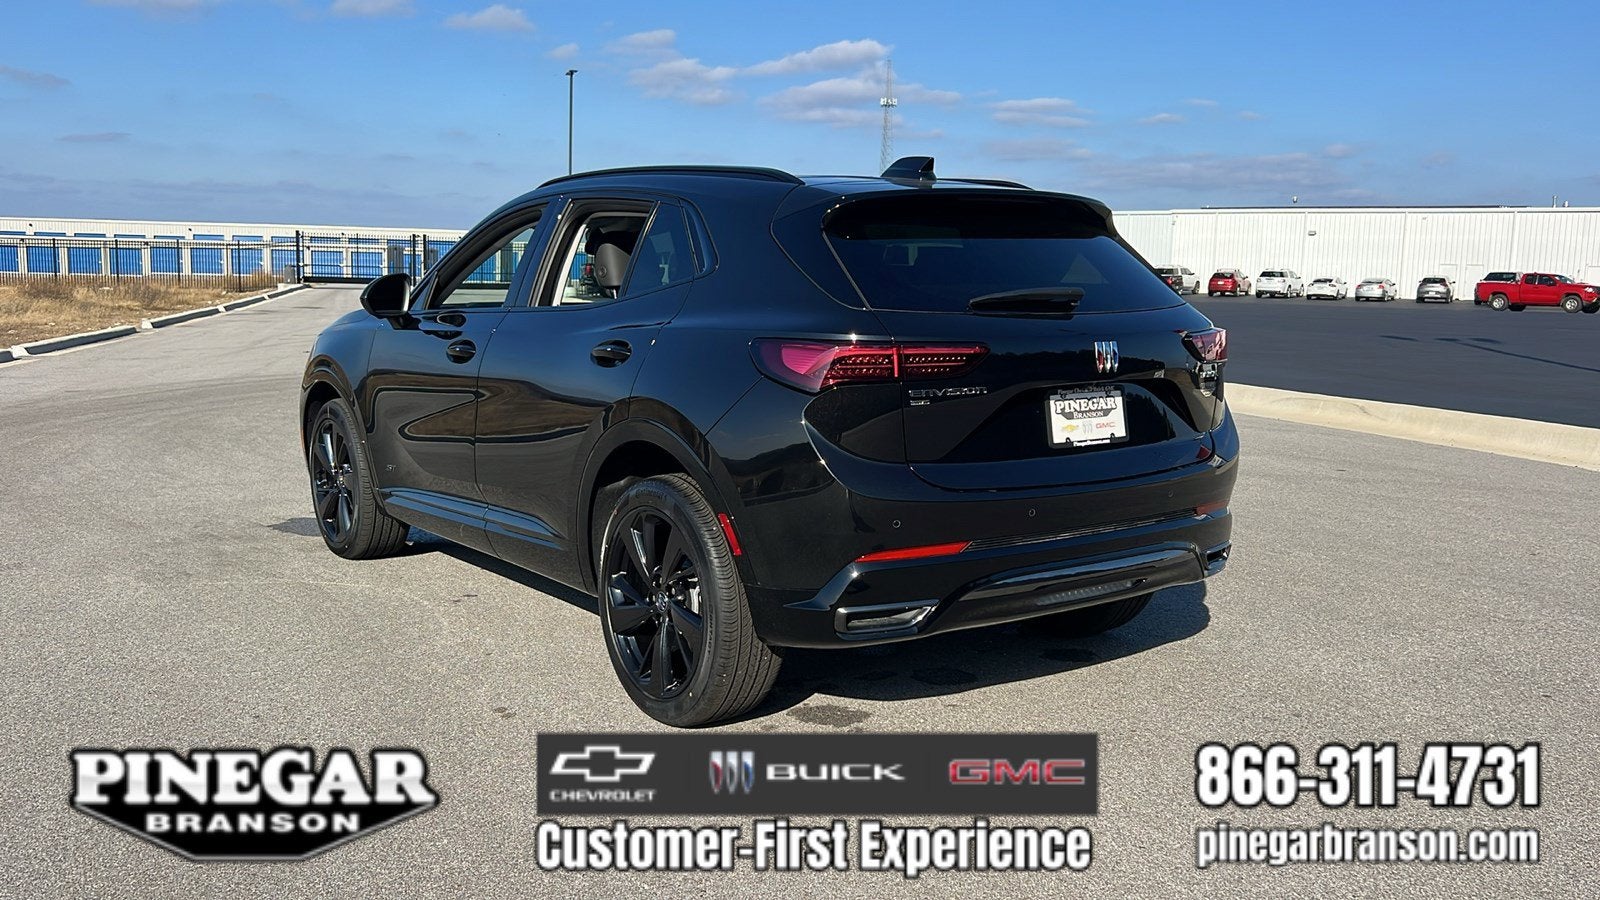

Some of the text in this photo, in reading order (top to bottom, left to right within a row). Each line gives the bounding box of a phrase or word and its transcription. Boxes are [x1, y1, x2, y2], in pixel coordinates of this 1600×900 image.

[1055, 397, 1117, 414] PINEGAR
[1073, 411, 1104, 419] BRANSON
[1095, 421, 1116, 429] GMC
